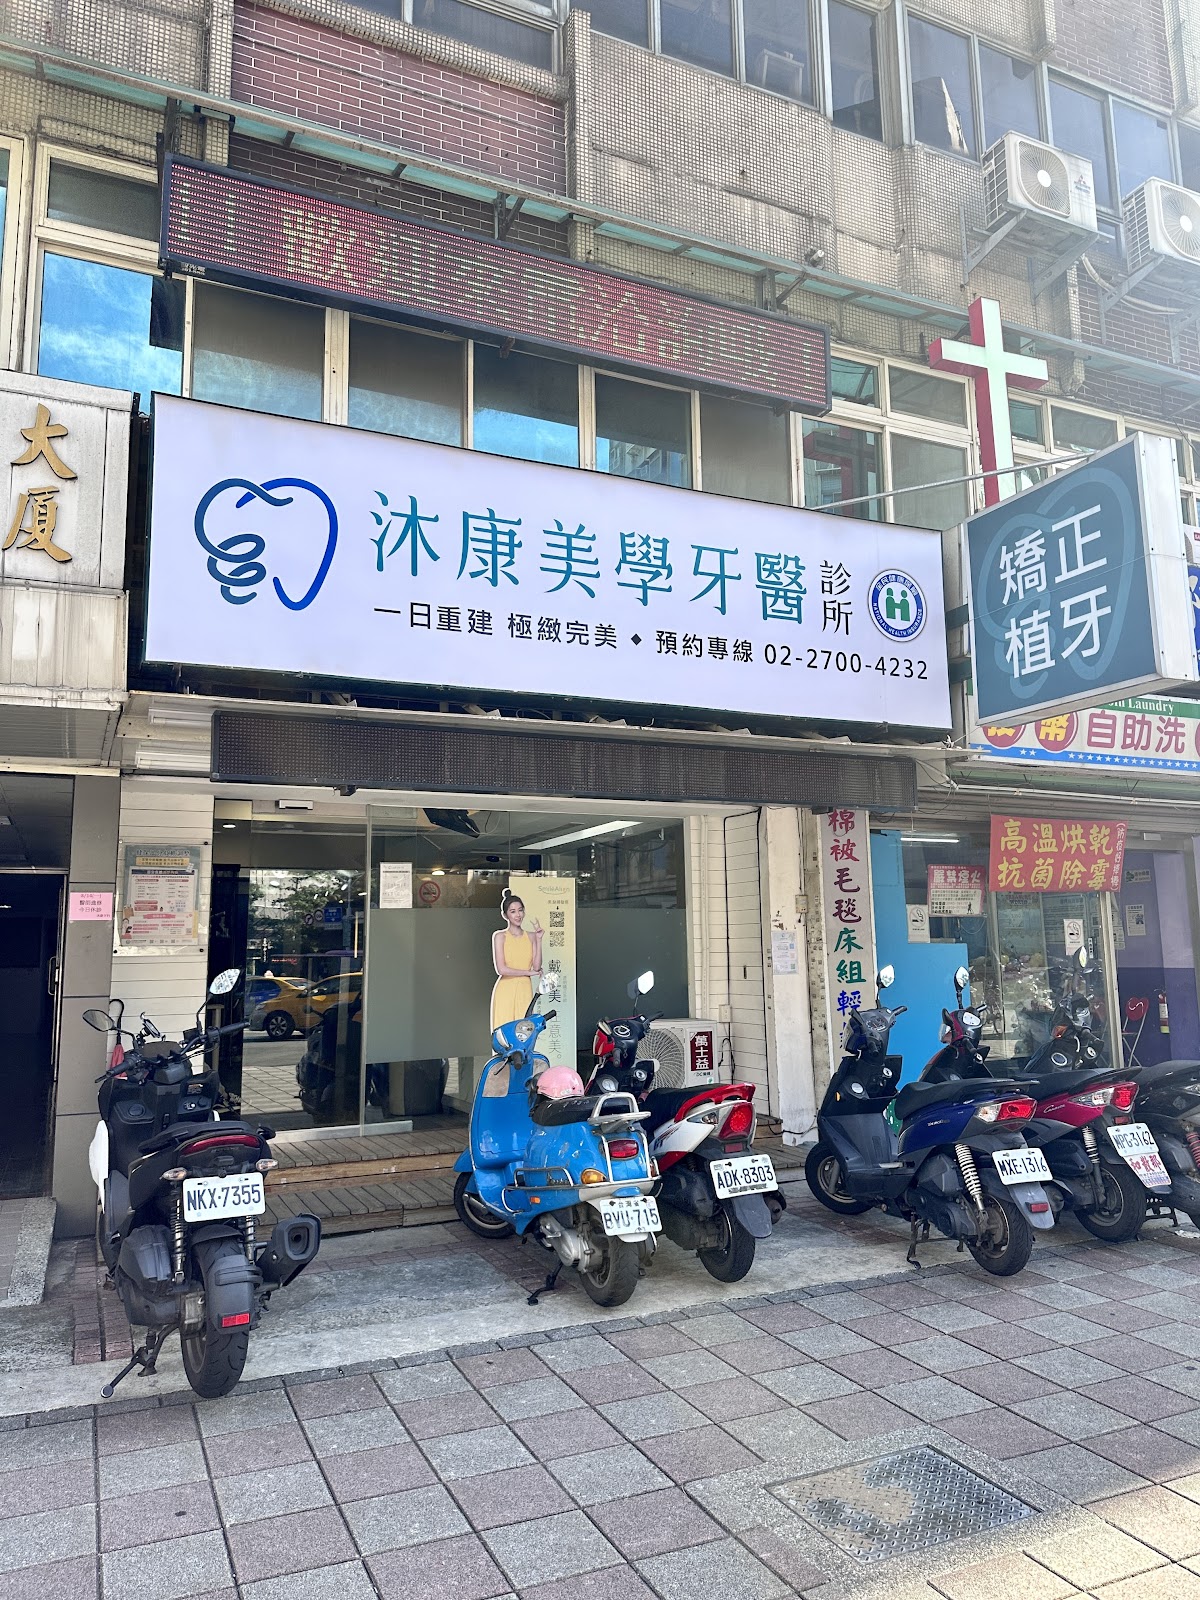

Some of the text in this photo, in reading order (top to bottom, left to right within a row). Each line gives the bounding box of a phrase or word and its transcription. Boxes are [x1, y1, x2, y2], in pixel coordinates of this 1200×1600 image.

[2, 403, 78, 563] 大廈
[369, 489, 853, 637] 沐康美學牙醫 診所
[998, 503, 1109, 606] 矯正
[373, 602, 930, 681] 一日重建 極緻完美 預約專線 02-2700-4232
[1004, 584, 1113, 680] 植牙
[1128, 699, 1175, 715] Laundry
[997, 857, 1111, 891] 抗菌除霉
[1000, 819, 1114, 857] 高溫烘乾
[827, 809, 867, 1049] 棉被毛毯床組輕
[694, 1034, 710, 1070] 萬士益
